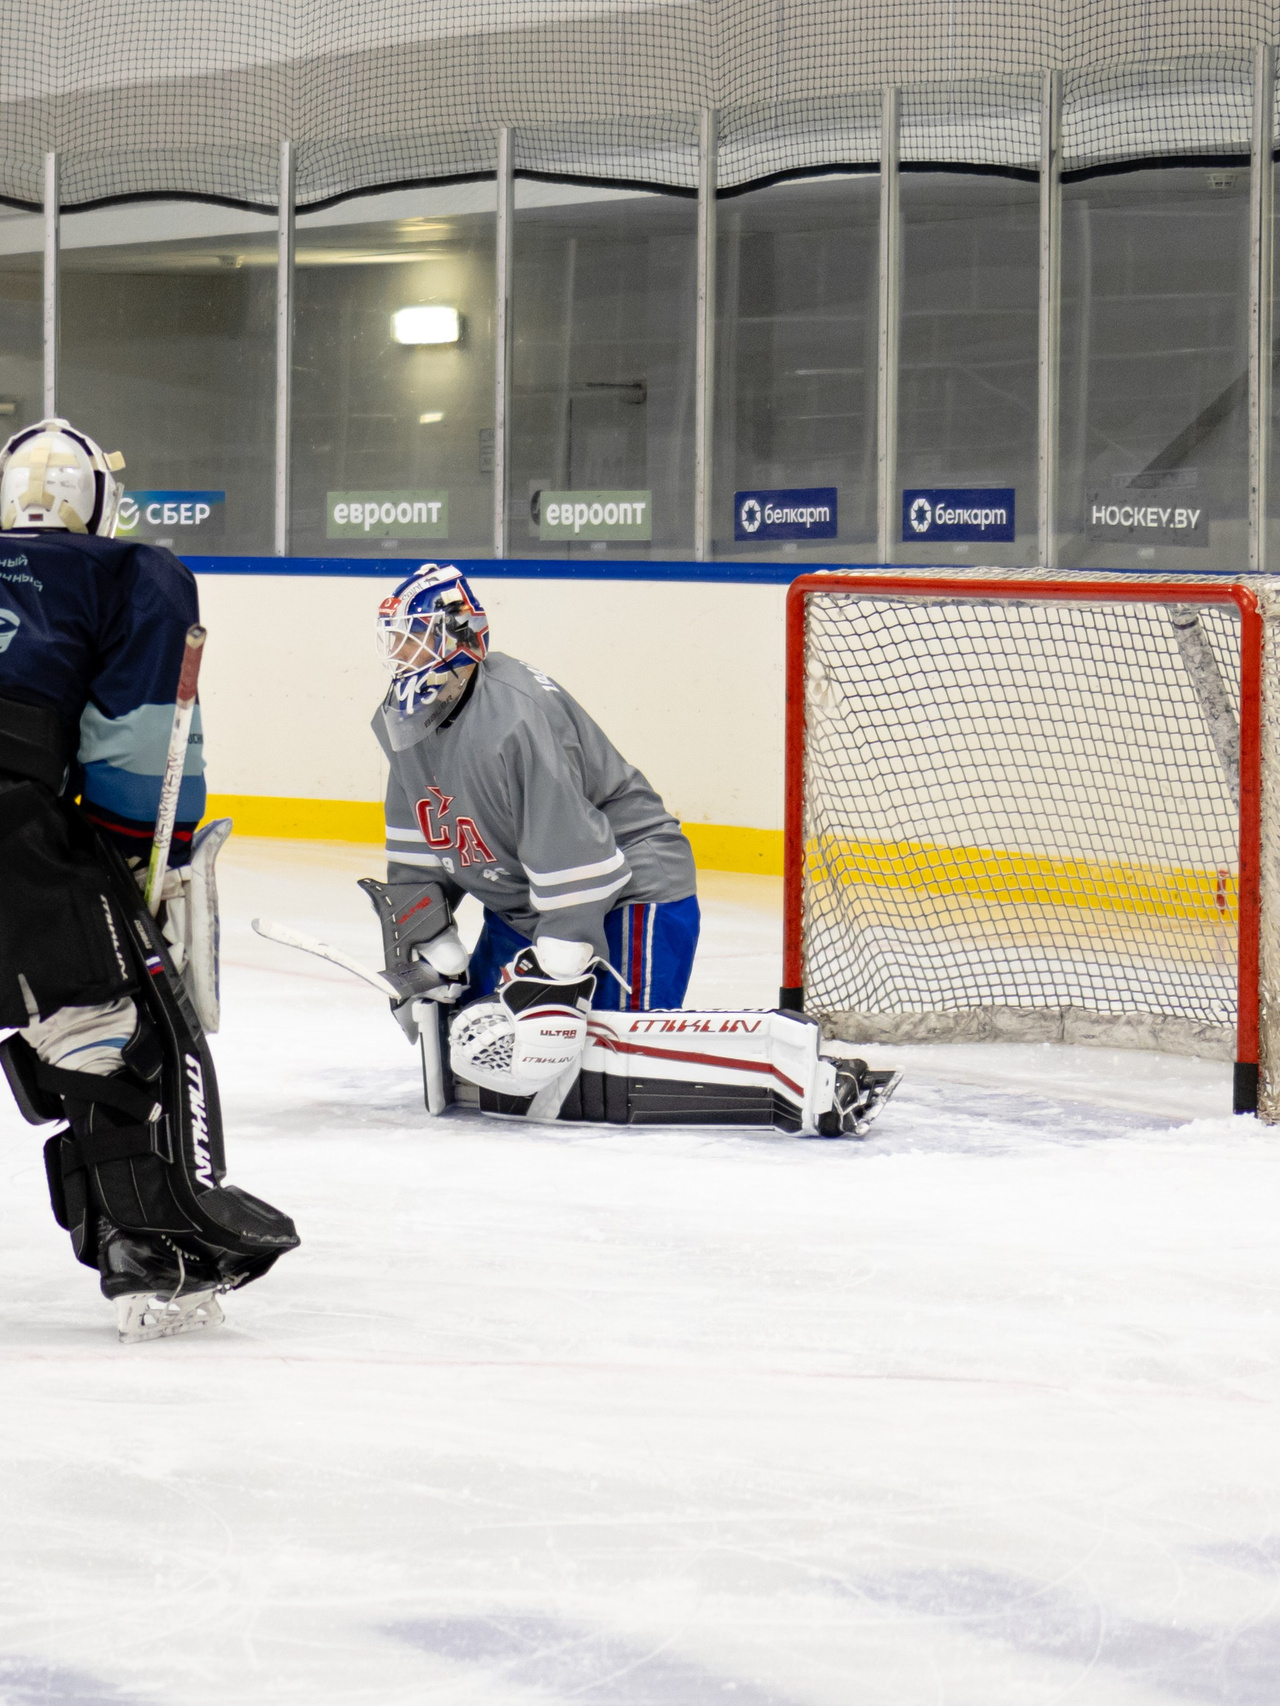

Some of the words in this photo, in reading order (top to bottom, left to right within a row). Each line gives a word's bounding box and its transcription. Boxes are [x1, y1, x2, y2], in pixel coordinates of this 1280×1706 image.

[146, 503, 210, 525] СБЕР
[333, 502, 442, 531] евроопт
[546, 502, 646, 533] евроопт
[764, 504, 830, 528] белкарт
[935, 503, 1007, 530] белкарт
[1092, 505, 1201, 528] HOCKEY.BY
[628, 1019, 763, 1033] MIKLIN
